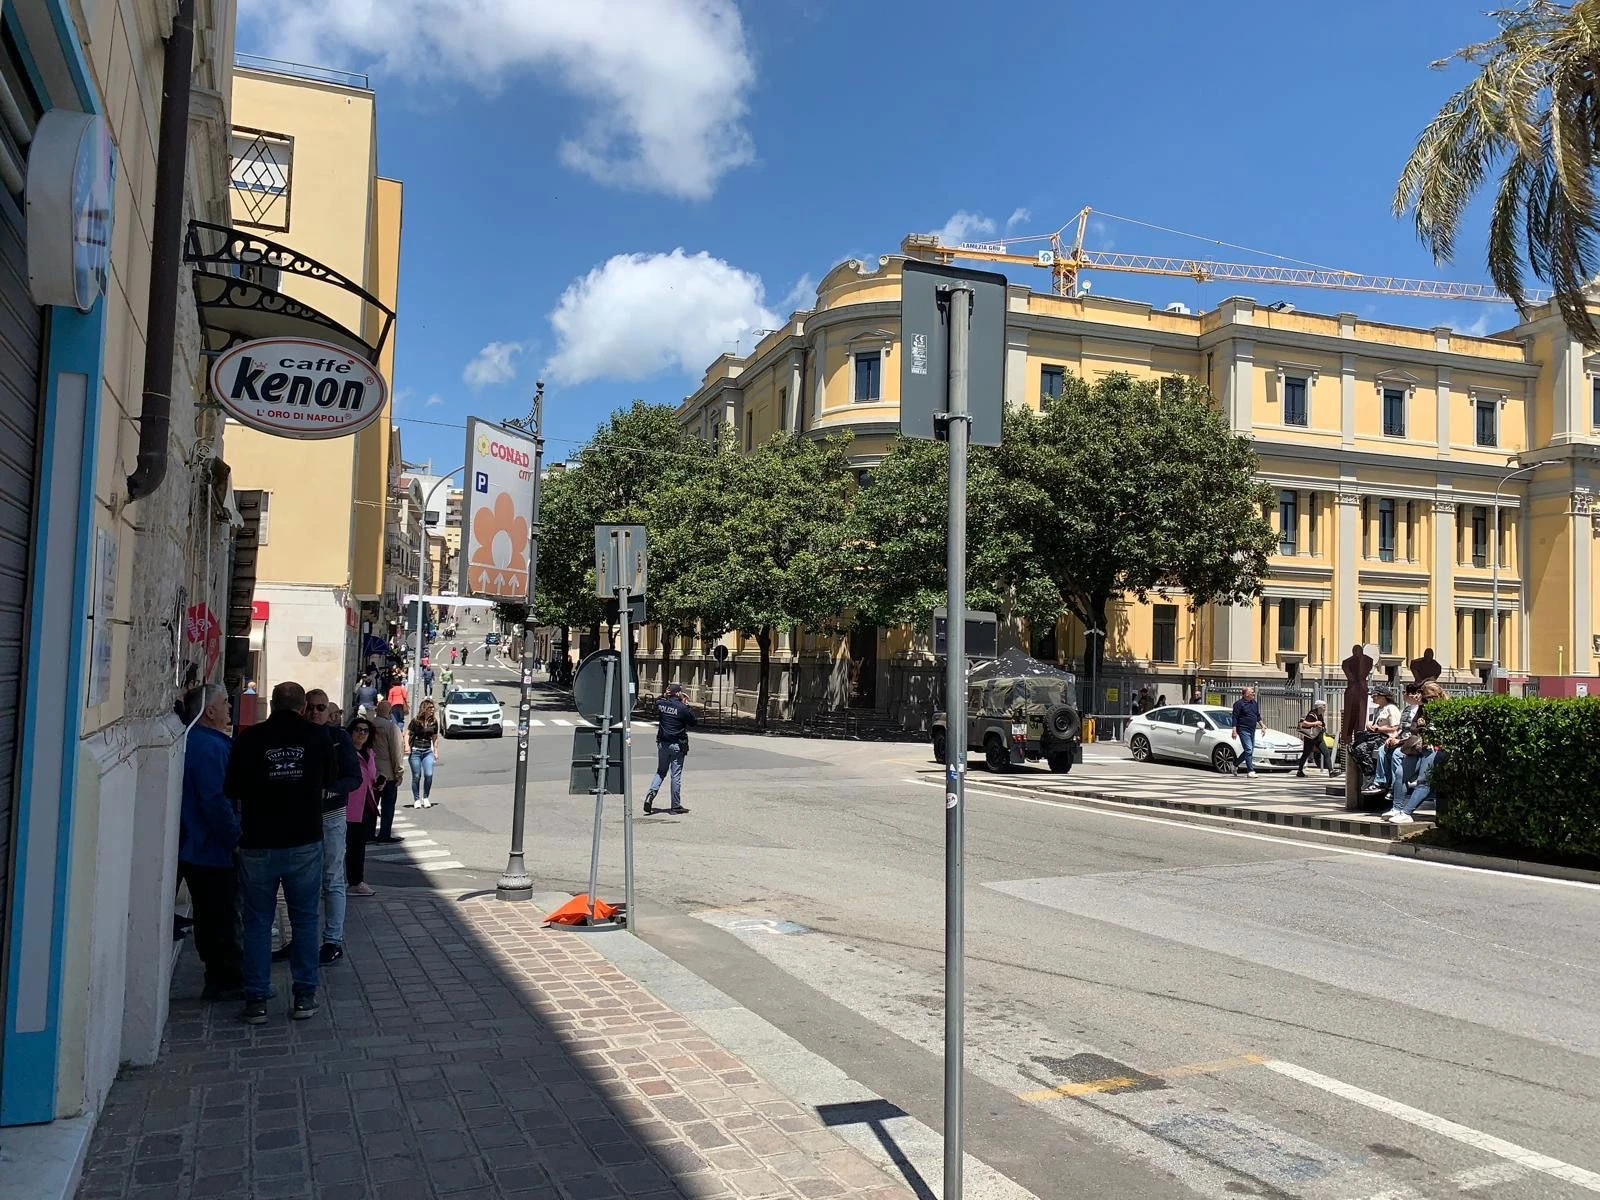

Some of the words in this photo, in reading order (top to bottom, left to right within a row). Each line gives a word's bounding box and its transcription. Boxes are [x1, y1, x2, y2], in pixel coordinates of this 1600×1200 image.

[230, 356, 366, 411] kenon
[267, 409, 290, 419] ORO
[293, 412, 304, 420] DI
[306, 413, 344, 423] NAPOLI
[490, 441, 530, 468] CONAD
[478, 474, 486, 490] P
[518, 469, 534, 482] CITY
[658, 704, 678, 716] POLIZIA
